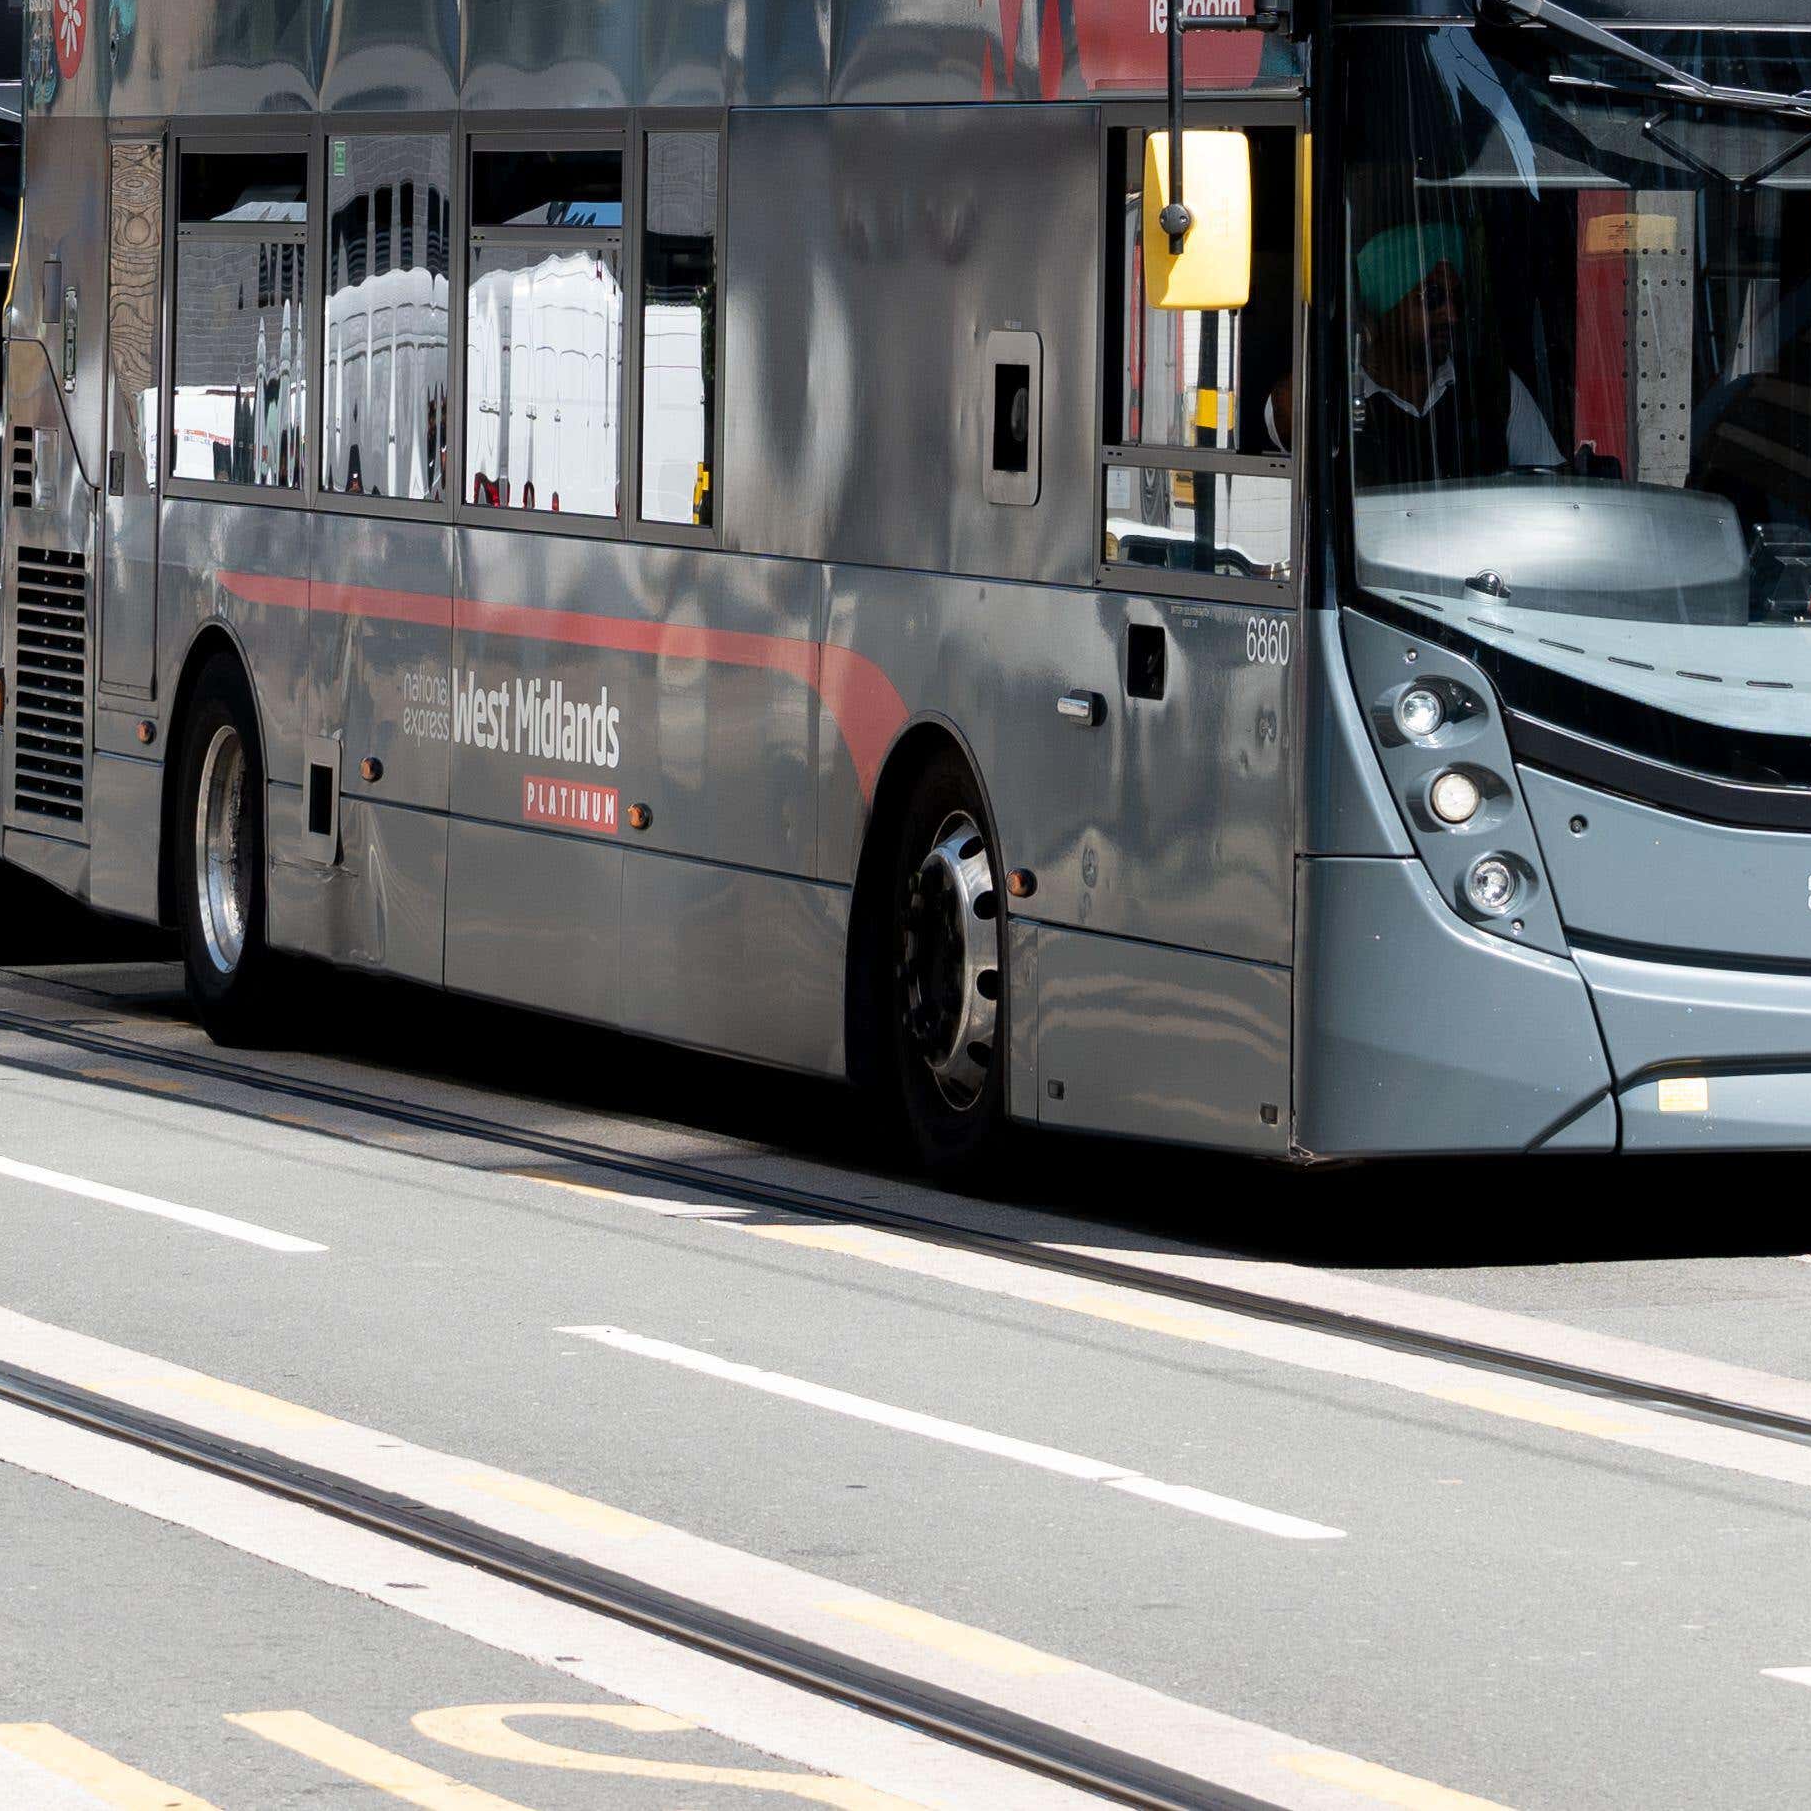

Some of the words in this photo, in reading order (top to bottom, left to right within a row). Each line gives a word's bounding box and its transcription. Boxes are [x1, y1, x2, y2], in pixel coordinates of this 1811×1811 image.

[1246, 616, 1290, 666] 6860
[403, 664, 450, 707] national
[453, 668, 510, 752] West
[515, 677, 620, 768] Midlands
[403, 706, 450, 748] express
[527, 781, 615, 825] PLATINUM
